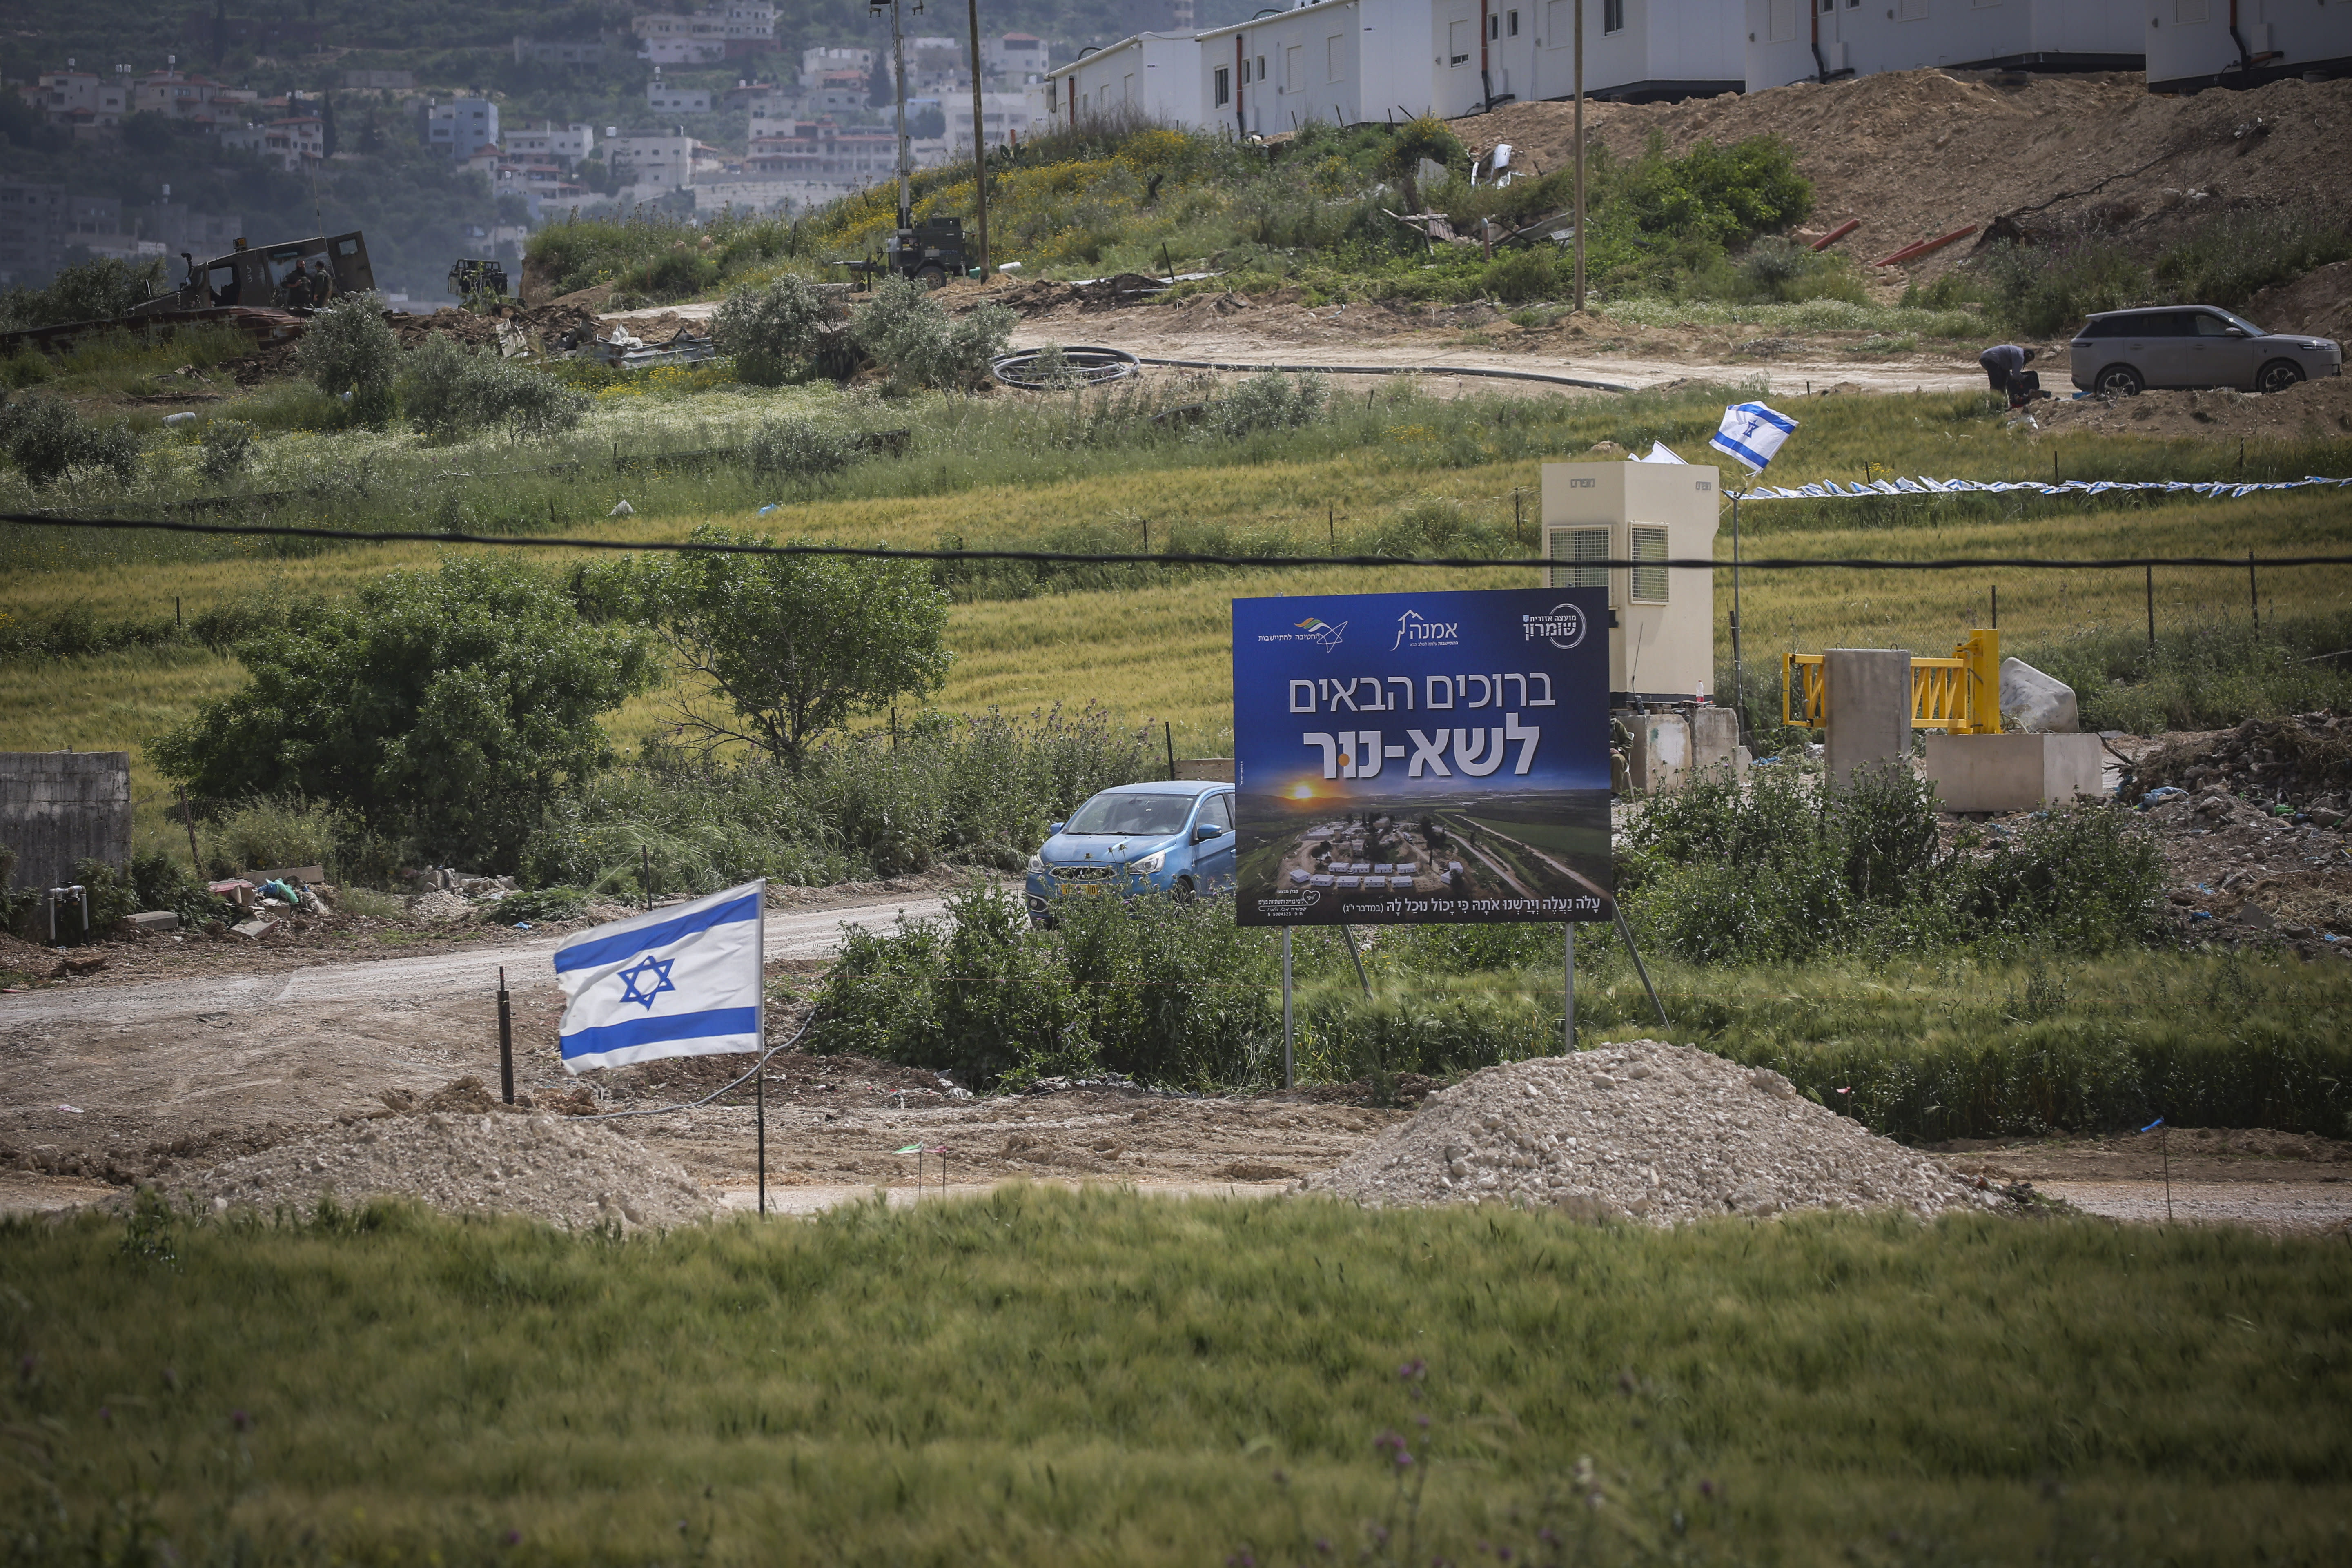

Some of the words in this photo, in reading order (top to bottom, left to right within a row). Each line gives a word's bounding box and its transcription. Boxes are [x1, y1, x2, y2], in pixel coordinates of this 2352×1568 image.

[1410, 623, 1457, 639] אמנה
[1523, 622, 1576, 641] שומרון
[1290, 676, 1413, 713] הבאים
[1427, 672, 1555, 709] ברוכים
